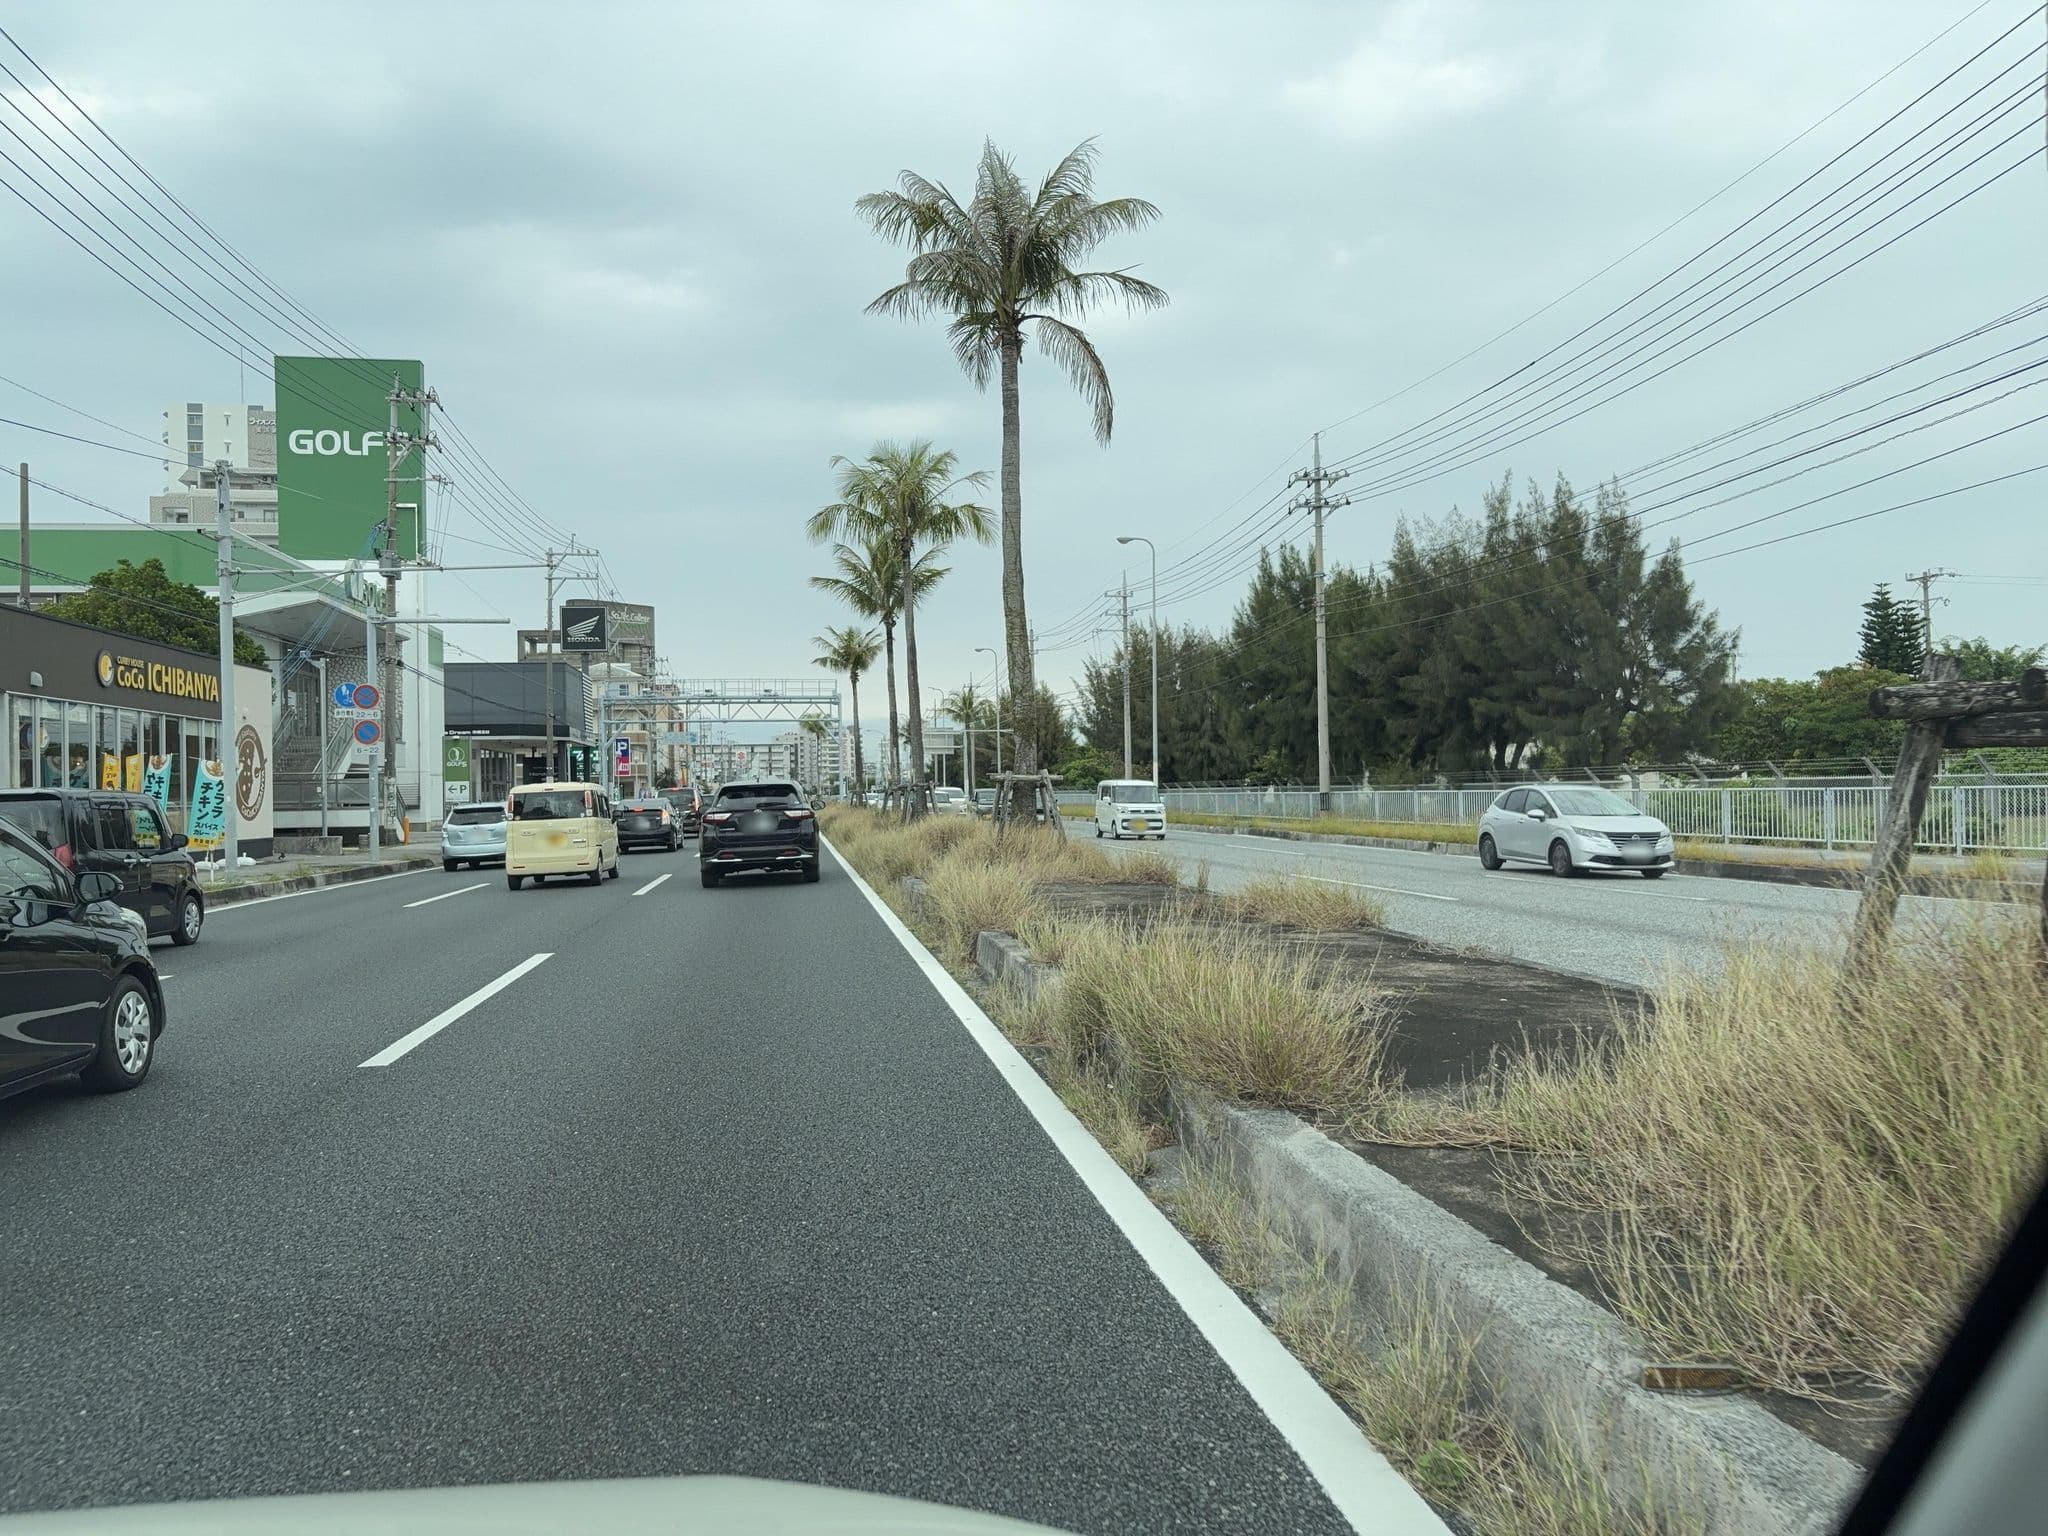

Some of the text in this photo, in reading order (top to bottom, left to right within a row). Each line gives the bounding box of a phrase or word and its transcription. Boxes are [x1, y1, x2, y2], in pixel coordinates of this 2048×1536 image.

[117, 662, 219, 703] CoCo ICHIBANYA
[459, 784, 467, 794] P
[196, 782, 214, 821] チキン
[194, 821, 219, 831] スパイス
